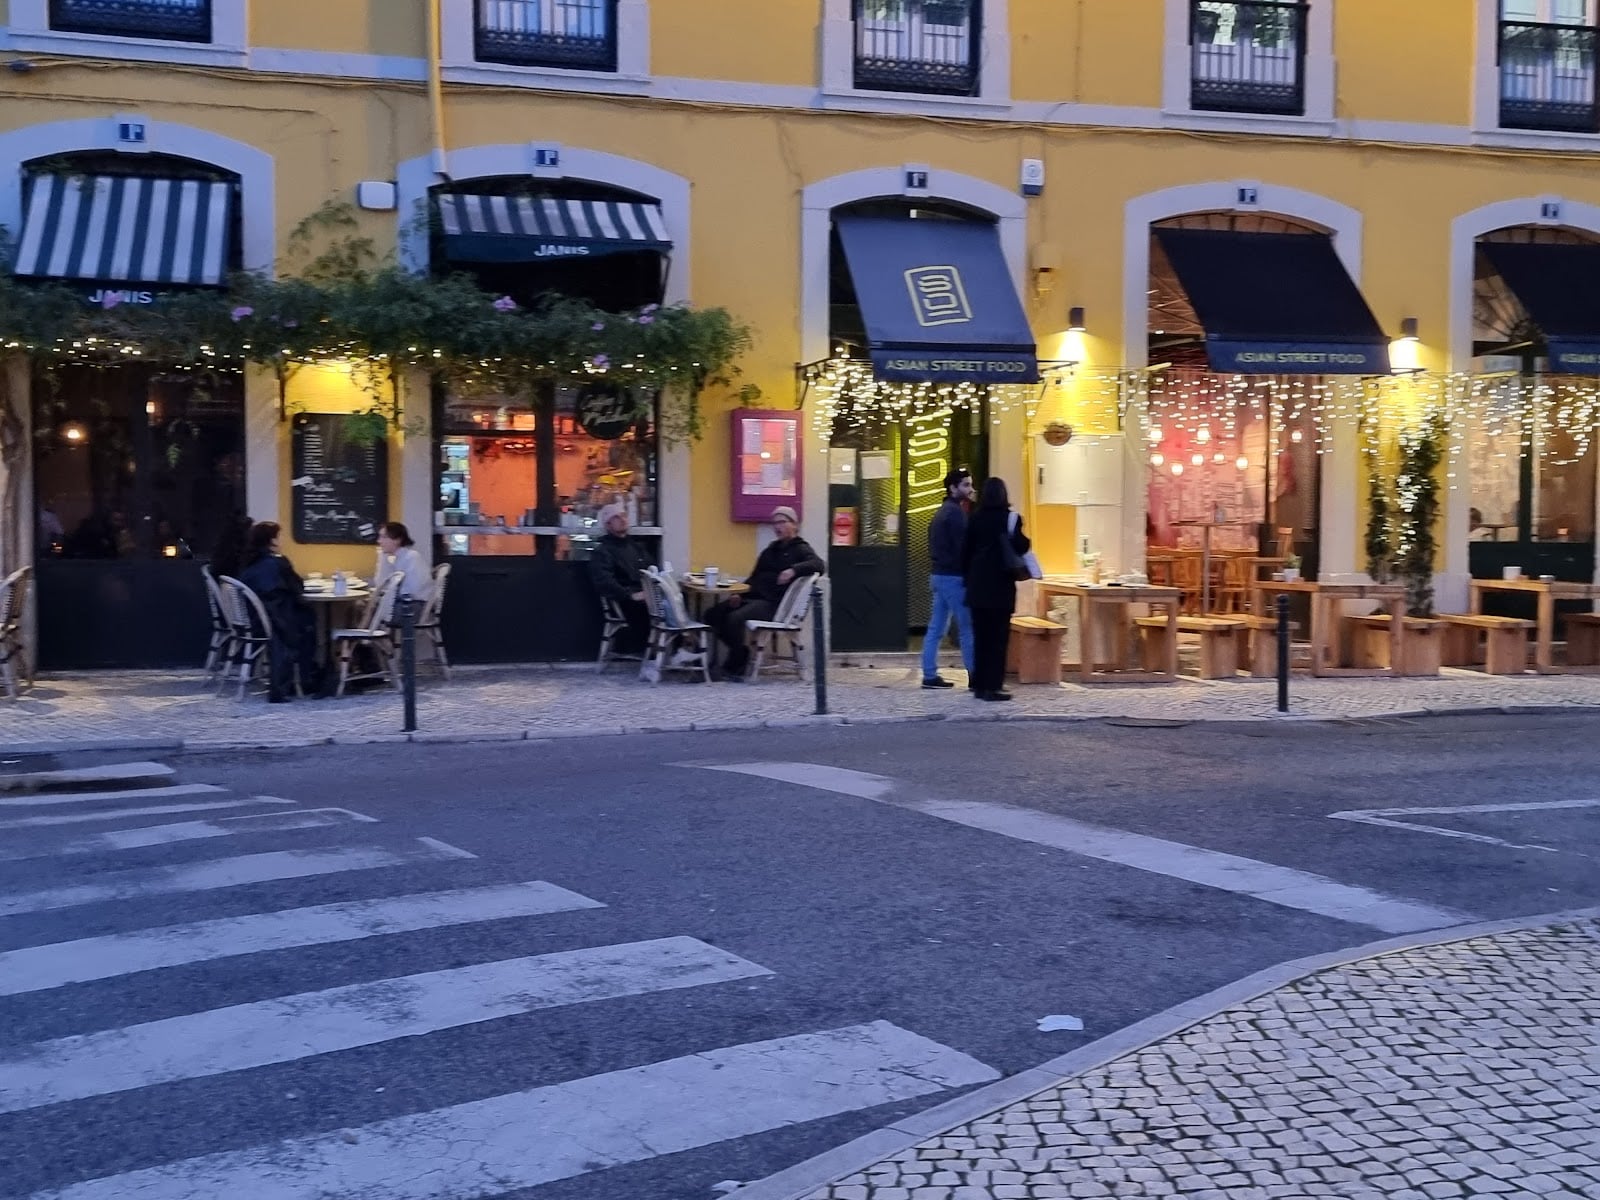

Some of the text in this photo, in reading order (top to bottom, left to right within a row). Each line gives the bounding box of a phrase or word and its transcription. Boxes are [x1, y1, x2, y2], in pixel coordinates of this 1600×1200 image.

[534, 244, 590, 256] JANIS
[1234, 352, 1366, 364] ASIAN STREET FOOD
[885, 359, 1027, 373] ASIAN STREET FOOD
